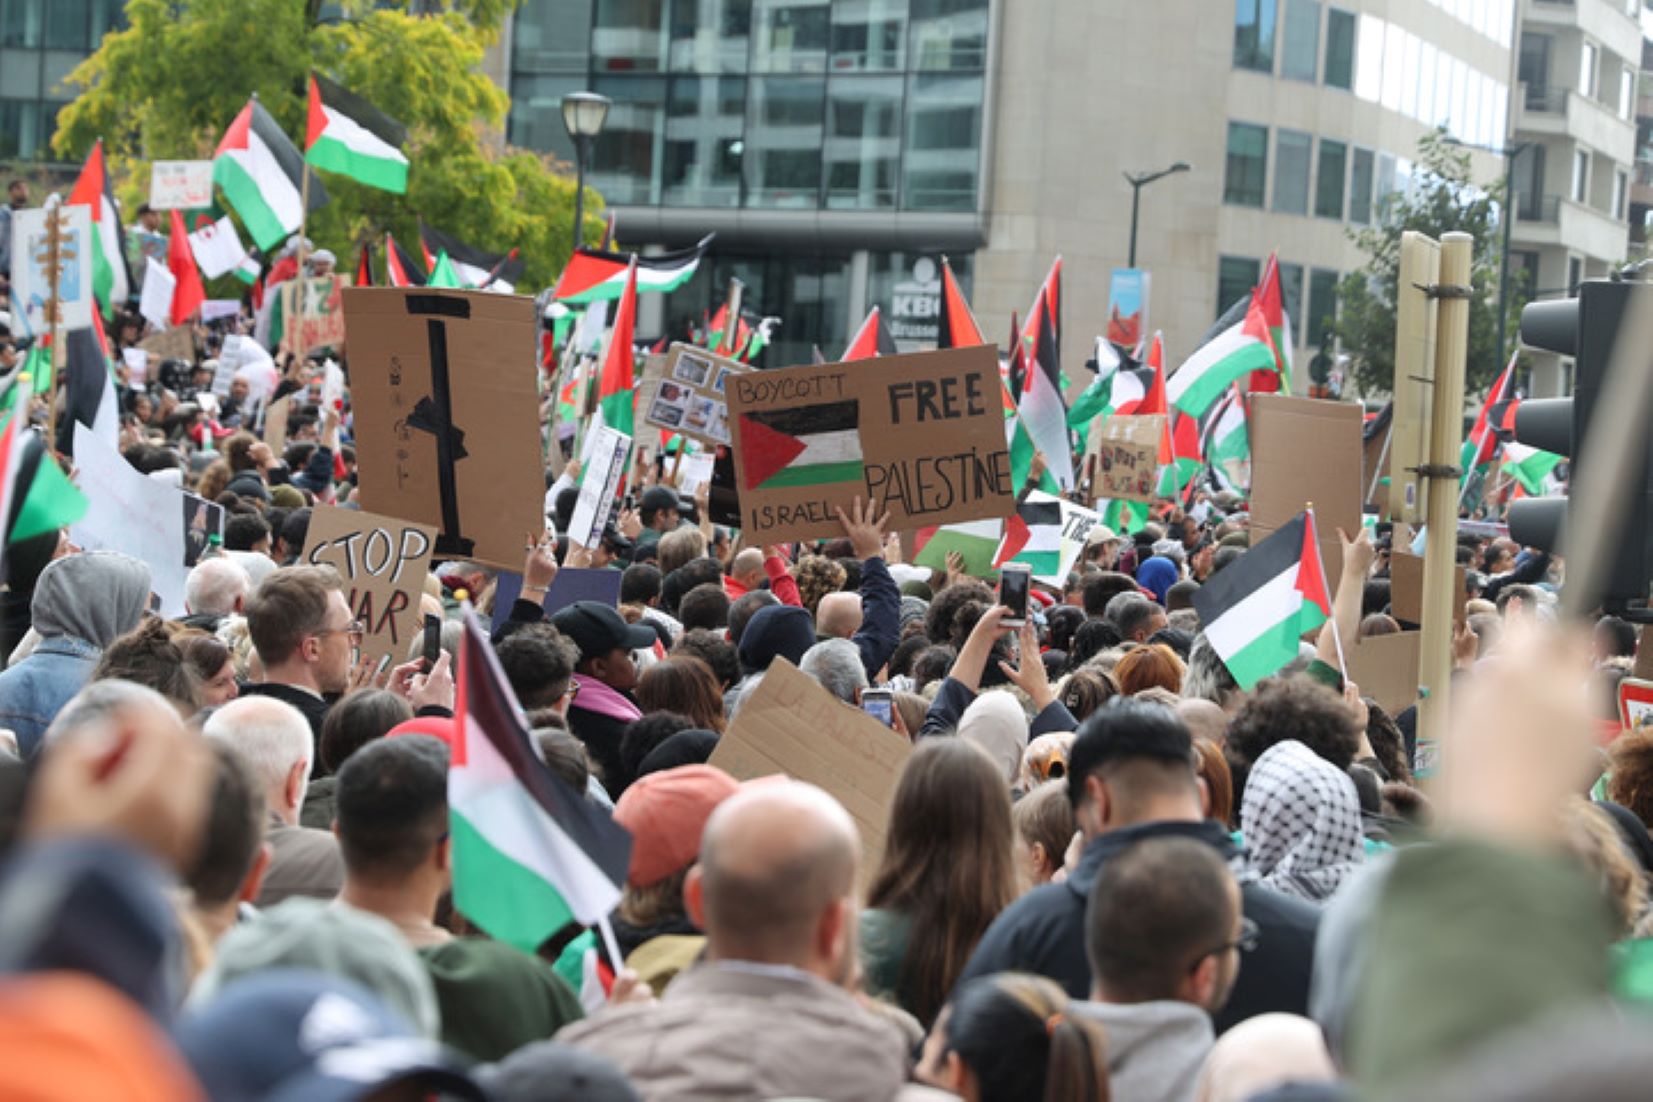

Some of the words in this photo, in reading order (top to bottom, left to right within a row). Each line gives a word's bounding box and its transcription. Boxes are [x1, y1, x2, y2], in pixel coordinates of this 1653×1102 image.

[736, 373, 845, 404] BOYCOTT
[887, 373, 985, 424] FREE
[864, 446, 1013, 526] PALESTINE
[752, 500, 840, 530] ISRAEL
